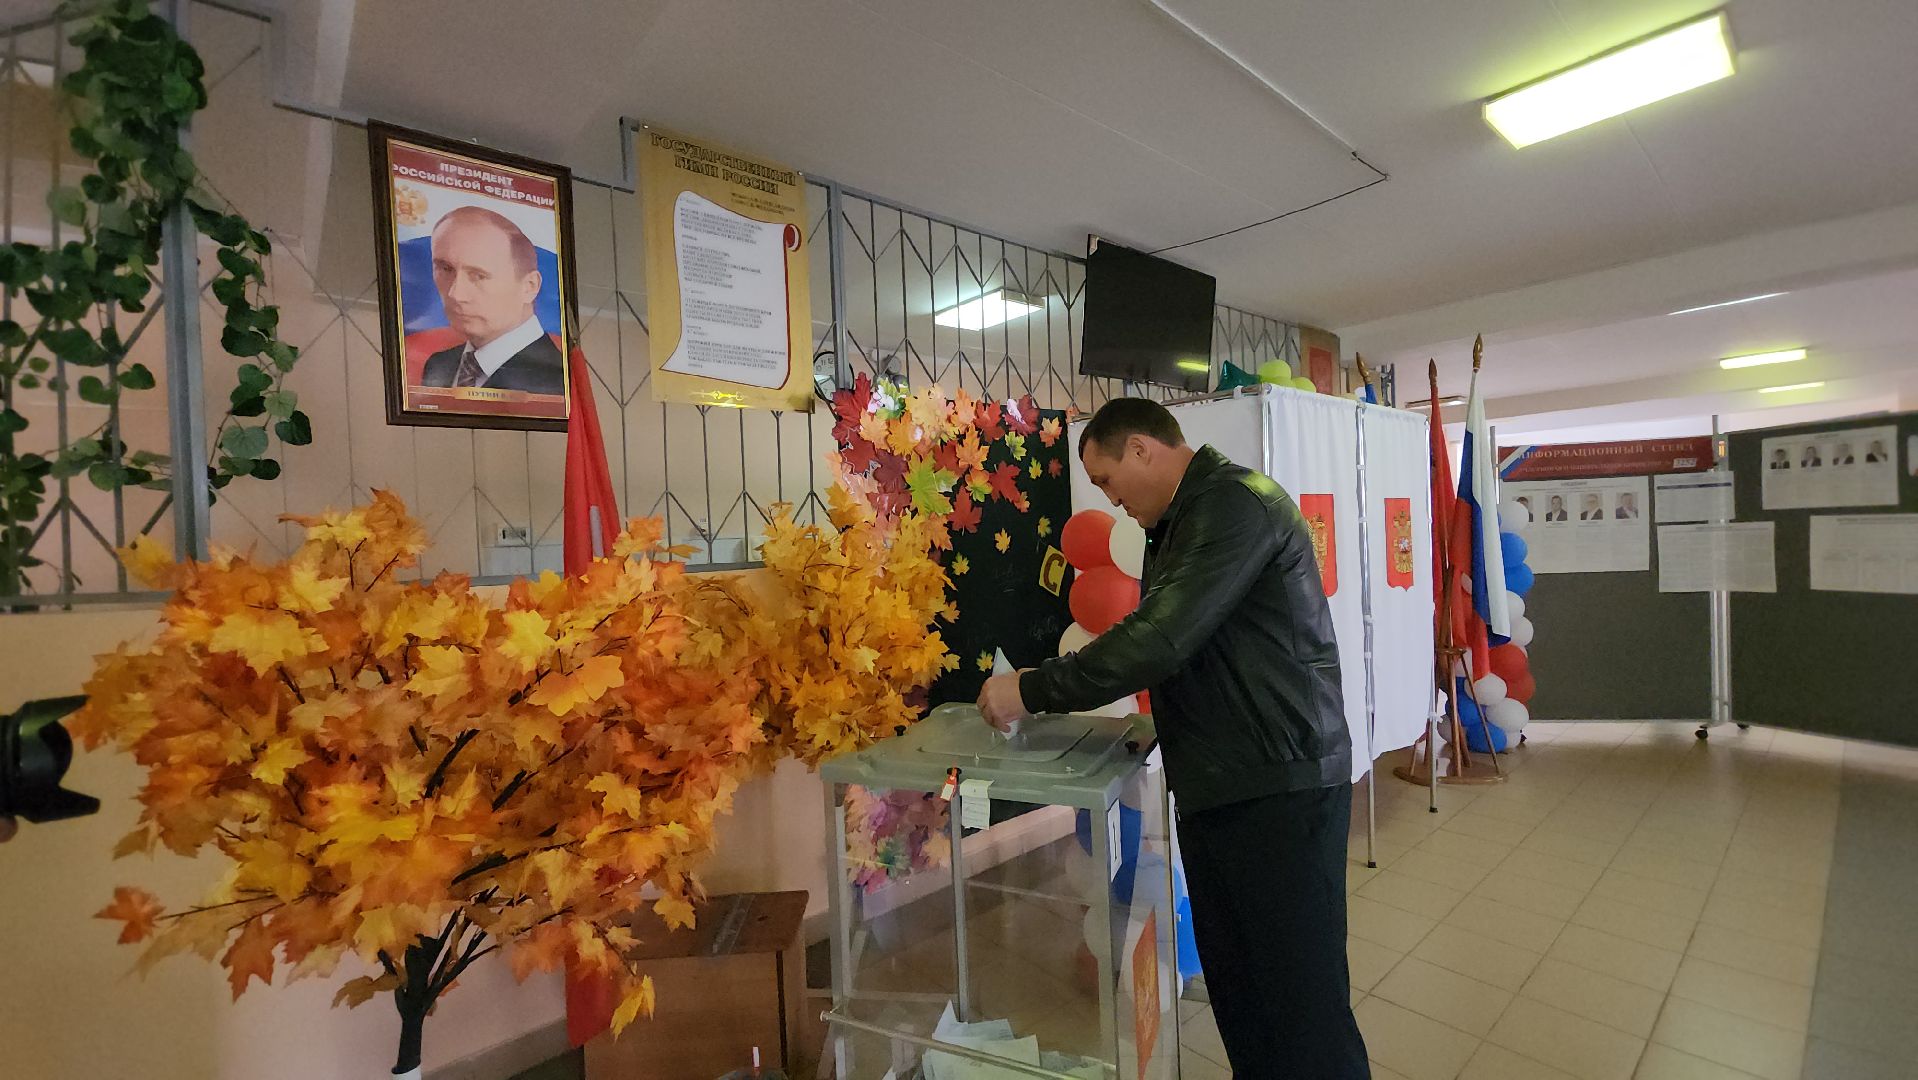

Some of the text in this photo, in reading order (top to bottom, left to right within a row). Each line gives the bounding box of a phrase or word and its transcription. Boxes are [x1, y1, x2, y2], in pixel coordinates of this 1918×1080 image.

[439, 161, 514, 187] ПРЕЗИДЕНТ
[650, 132, 796, 187] ГОСУДАРСТВЕННЫЙ
[673, 154, 779, 196] ГИМН РОССИИ
